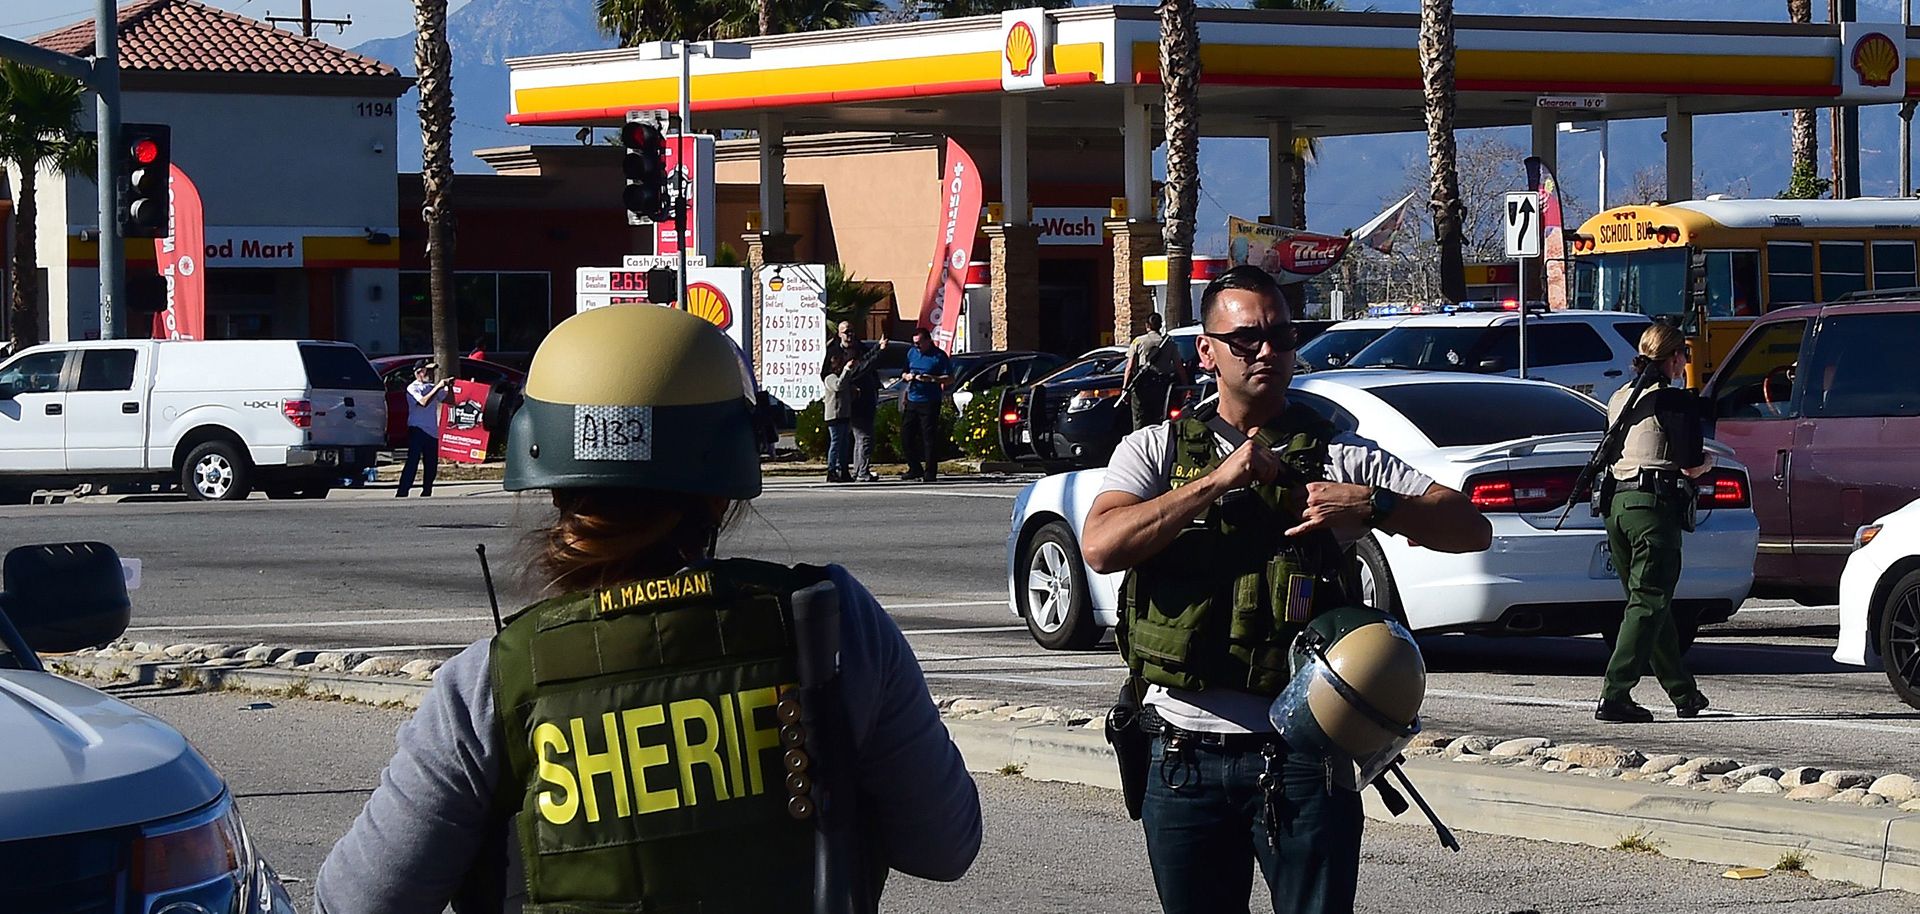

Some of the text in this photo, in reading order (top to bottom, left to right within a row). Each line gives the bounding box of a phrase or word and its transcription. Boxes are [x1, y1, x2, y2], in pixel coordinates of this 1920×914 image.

[357, 102, 393, 117] 1194
[1539, 98, 1577, 108] Clearance
[1042, 216, 1095, 236] Wash
[1600, 222, 1633, 244] SCHOOL
[205, 238, 294, 258] od Mart
[626, 257, 704, 267] Cash/Shell ard
[611, 272, 644, 290] 2.65
[585, 299, 597, 307] Plus
[765, 315, 785, 329] 265
[794, 315, 813, 329] 275
[765, 338, 785, 352] 275
[794, 338, 814, 352] 285
[766, 362, 785, 375] 285
[794, 362, 814, 375] 295
[794, 385, 814, 399] 289
[582, 413, 646, 451] A132
[600, 574, 707, 612] M. MACEWAN
[533, 684, 794, 825] SHERIF
